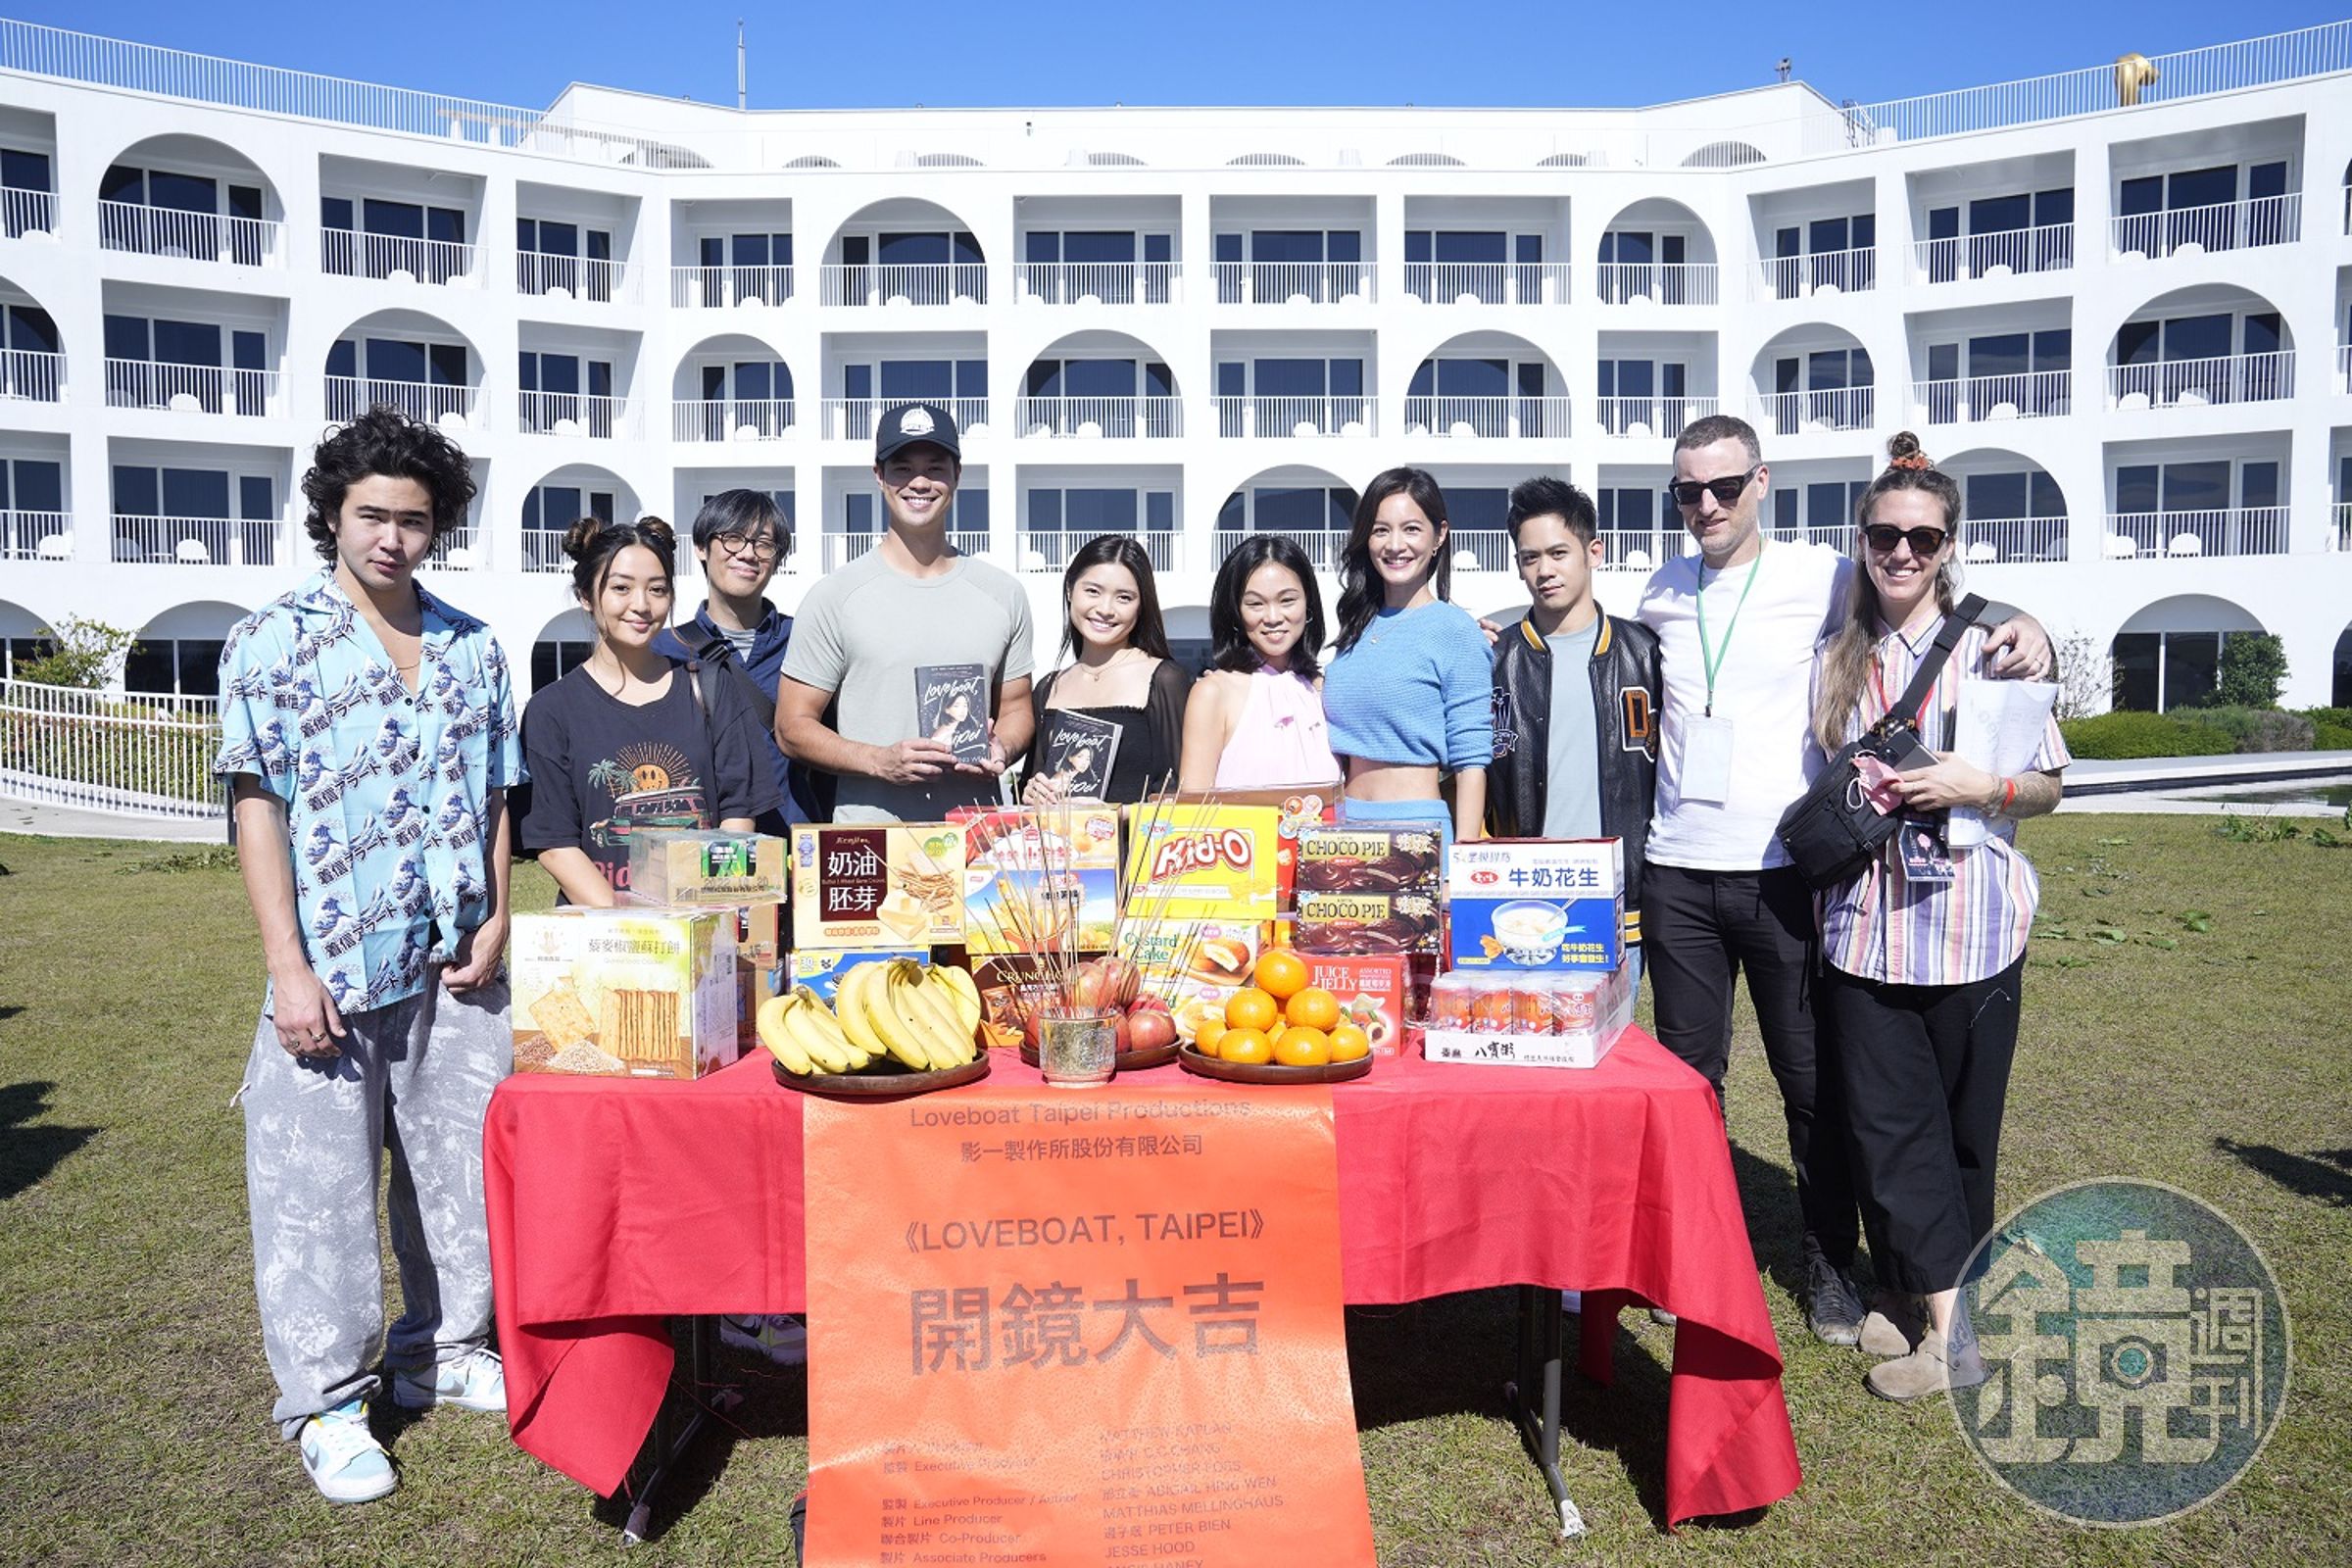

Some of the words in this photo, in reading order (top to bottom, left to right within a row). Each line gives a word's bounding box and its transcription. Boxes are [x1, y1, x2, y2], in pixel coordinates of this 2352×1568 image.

[1152, 829, 1250, 882] Kid-O
[1306, 840, 1359, 856] CHOCO
[1362, 841, 1386, 856] PIE
[827, 851, 877, 877] 奶油
[1509, 867, 1599, 887] 牛奶花生
[828, 886, 878, 911] 胚芽
[1306, 903, 1359, 918] CHOCO
[1362, 904, 1386, 918] PIE
[1312, 965, 1349, 986] JUICE
[1320, 978, 1358, 991] JELLY
[910, 1105, 1020, 1127] Loveboat
[1029, 1101, 1101, 1124] Taipei
[1107, 1098, 1251, 1121] Productions
[960, 1134, 1202, 1164] 影一製作所股份有限公司
[911, 1272, 1268, 1376] 開鏡大吉
[913, 1496, 970, 1510] Executive
[972, 1494, 1026, 1507] Producer
[913, 1515, 941, 1527] Line
[943, 1512, 1004, 1525] Producer
[1102, 1503, 1177, 1520] MATTHIAS
[1149, 1521, 1195, 1537] PETER
[1199, 1518, 1232, 1533] BIEN
[938, 1533, 1021, 1545] Co-Producer
[912, 1551, 977, 1564] Associate
[979, 1552, 1048, 1564] Producers
[1104, 1543, 1149, 1559] JESSE
[1152, 1541, 1196, 1555] HOOD
